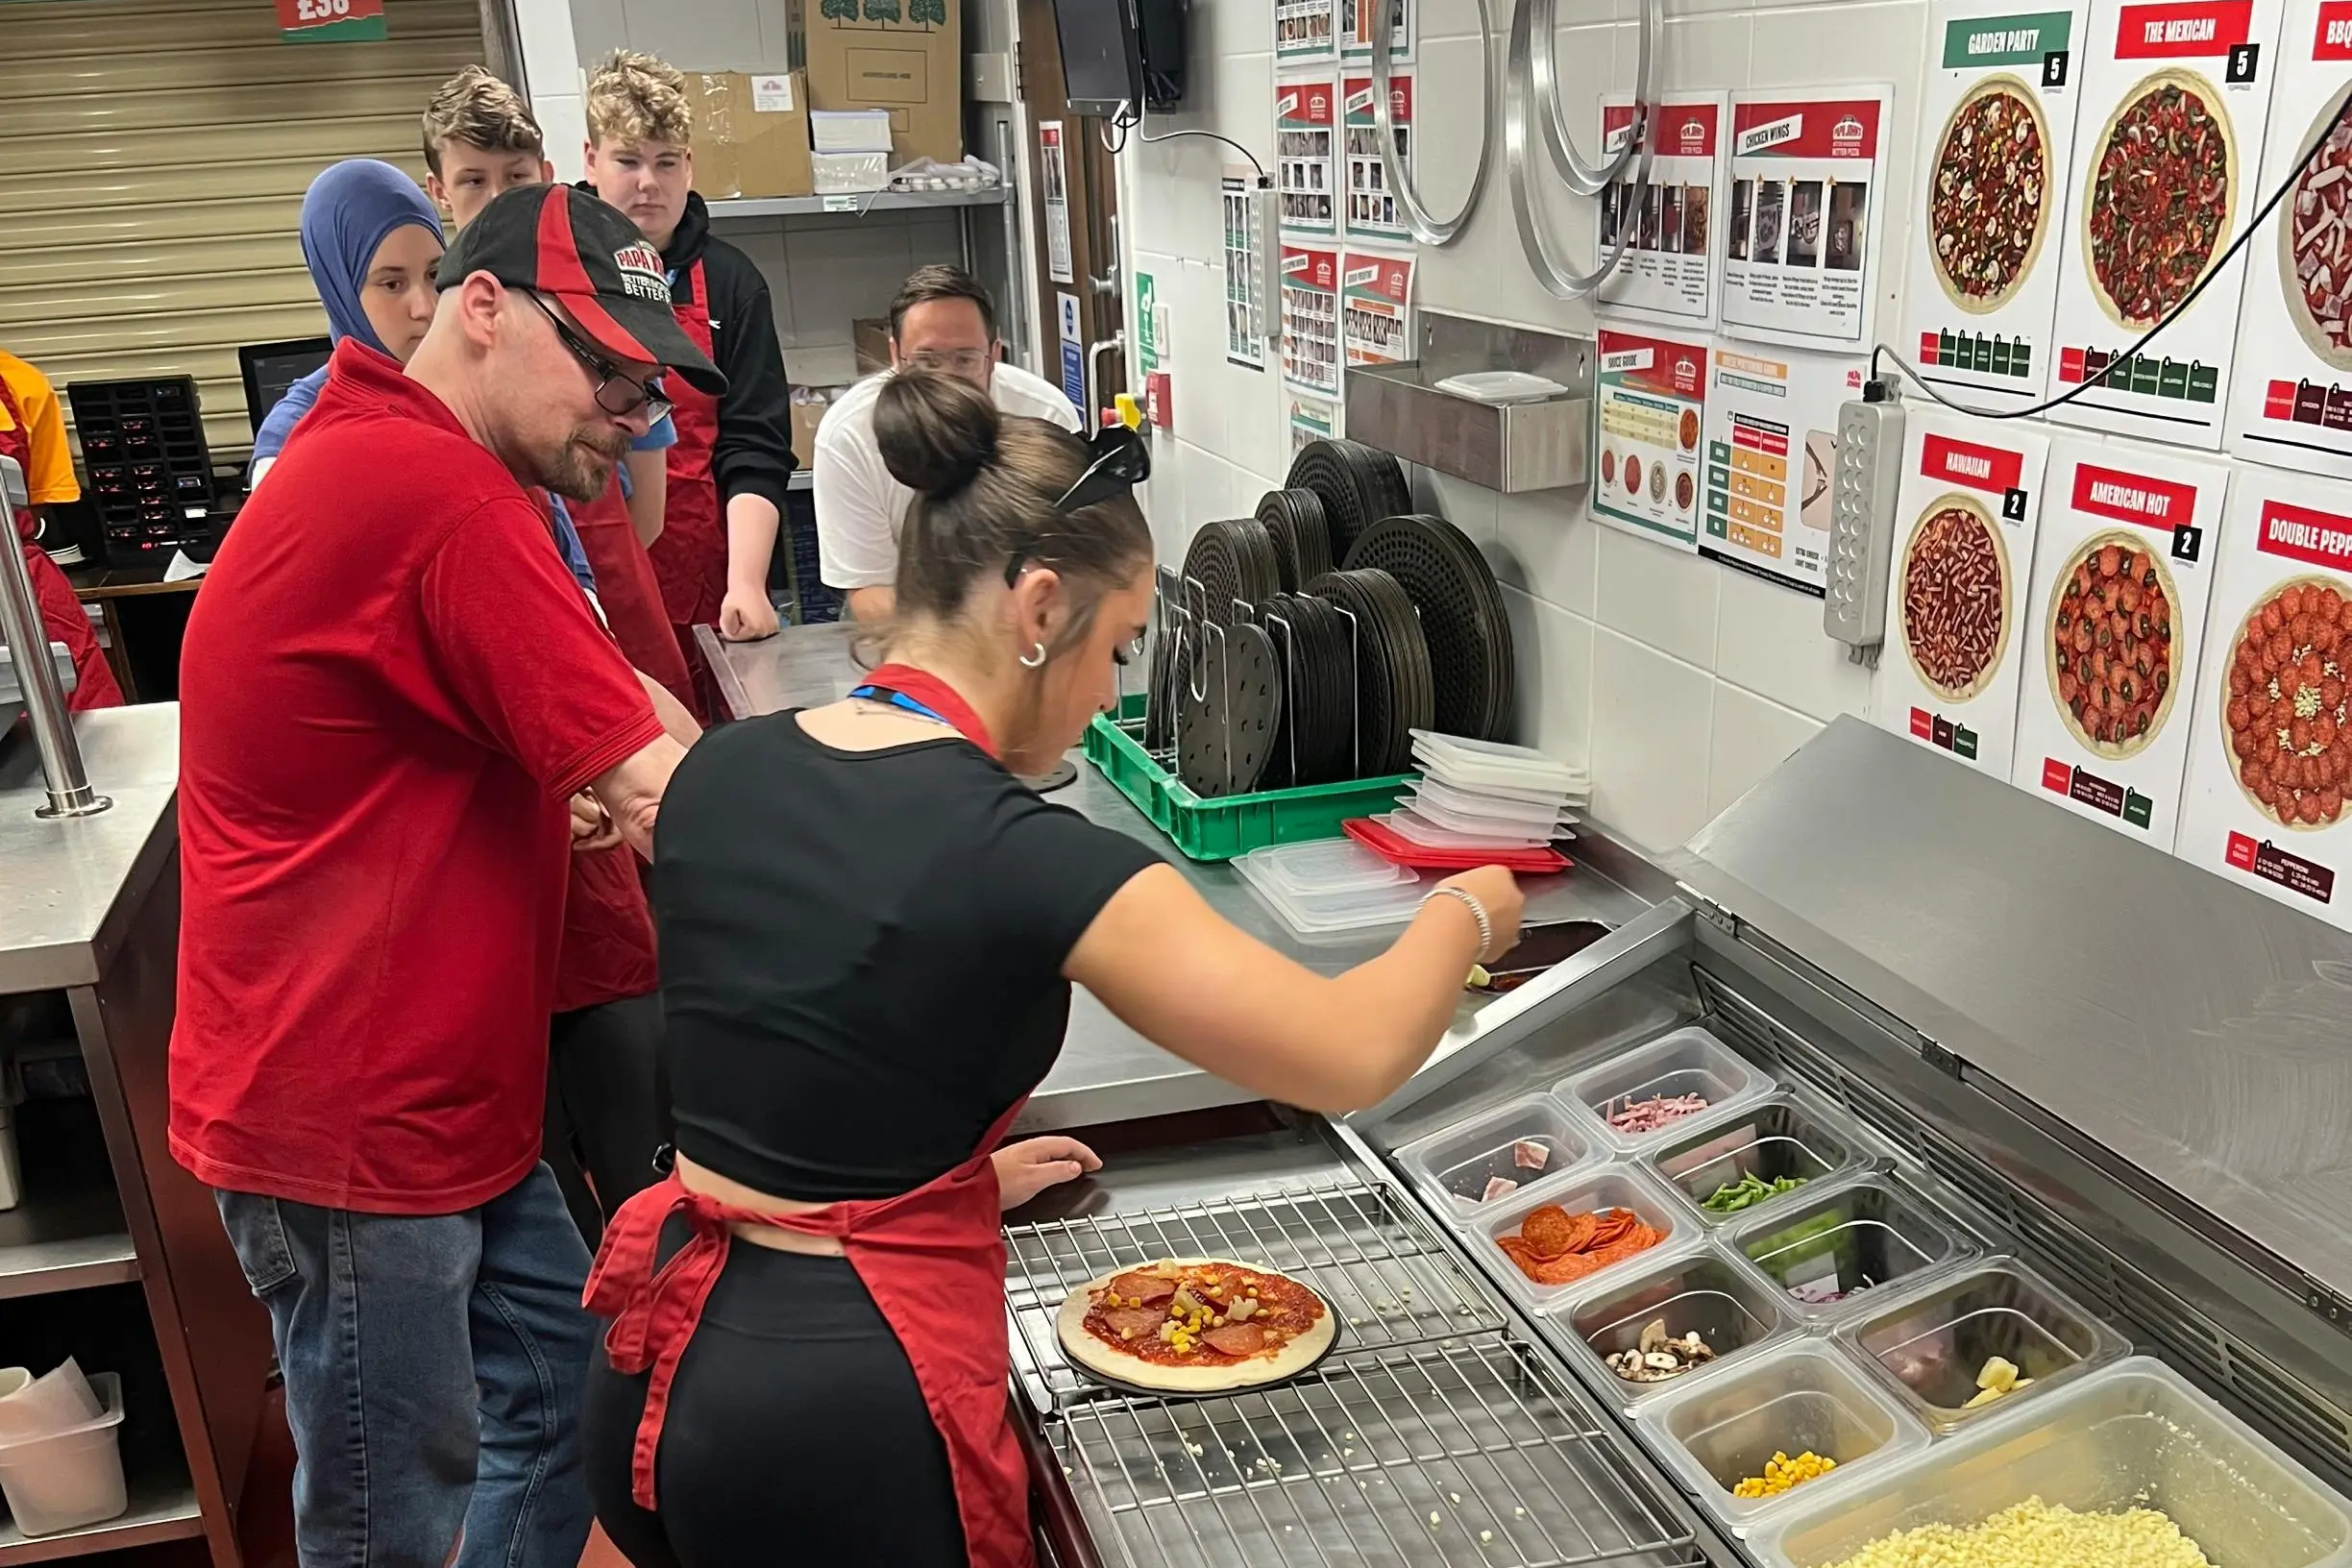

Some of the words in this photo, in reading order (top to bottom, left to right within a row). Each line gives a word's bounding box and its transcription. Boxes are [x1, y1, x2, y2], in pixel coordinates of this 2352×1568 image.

[1968, 31, 2006, 55] GARDEN
[2006, 29, 2040, 52] PARTY
[2144, 21, 2165, 43] THE
[2165, 18, 2217, 42] MEXICAN
[2326, 20, 2352, 48] BBQ
[2049, 58, 2061, 81] 5
[2236, 51, 2248, 76] 5
[1745, 129, 1770, 149] CHICKEN
[1770, 123, 1790, 141] WINGS
[617, 250, 651, 271] PAPA
[625, 282, 665, 303] BETTER
[1946, 452, 1991, 480] HAWAIIAN
[2010, 494, 2020, 514] 2
[2090, 481, 2146, 512] AMERICAN
[2145, 492, 2171, 517] HOT
[2180, 531, 2192, 553] 2
[2268, 518, 2320, 551] DOUBLE
